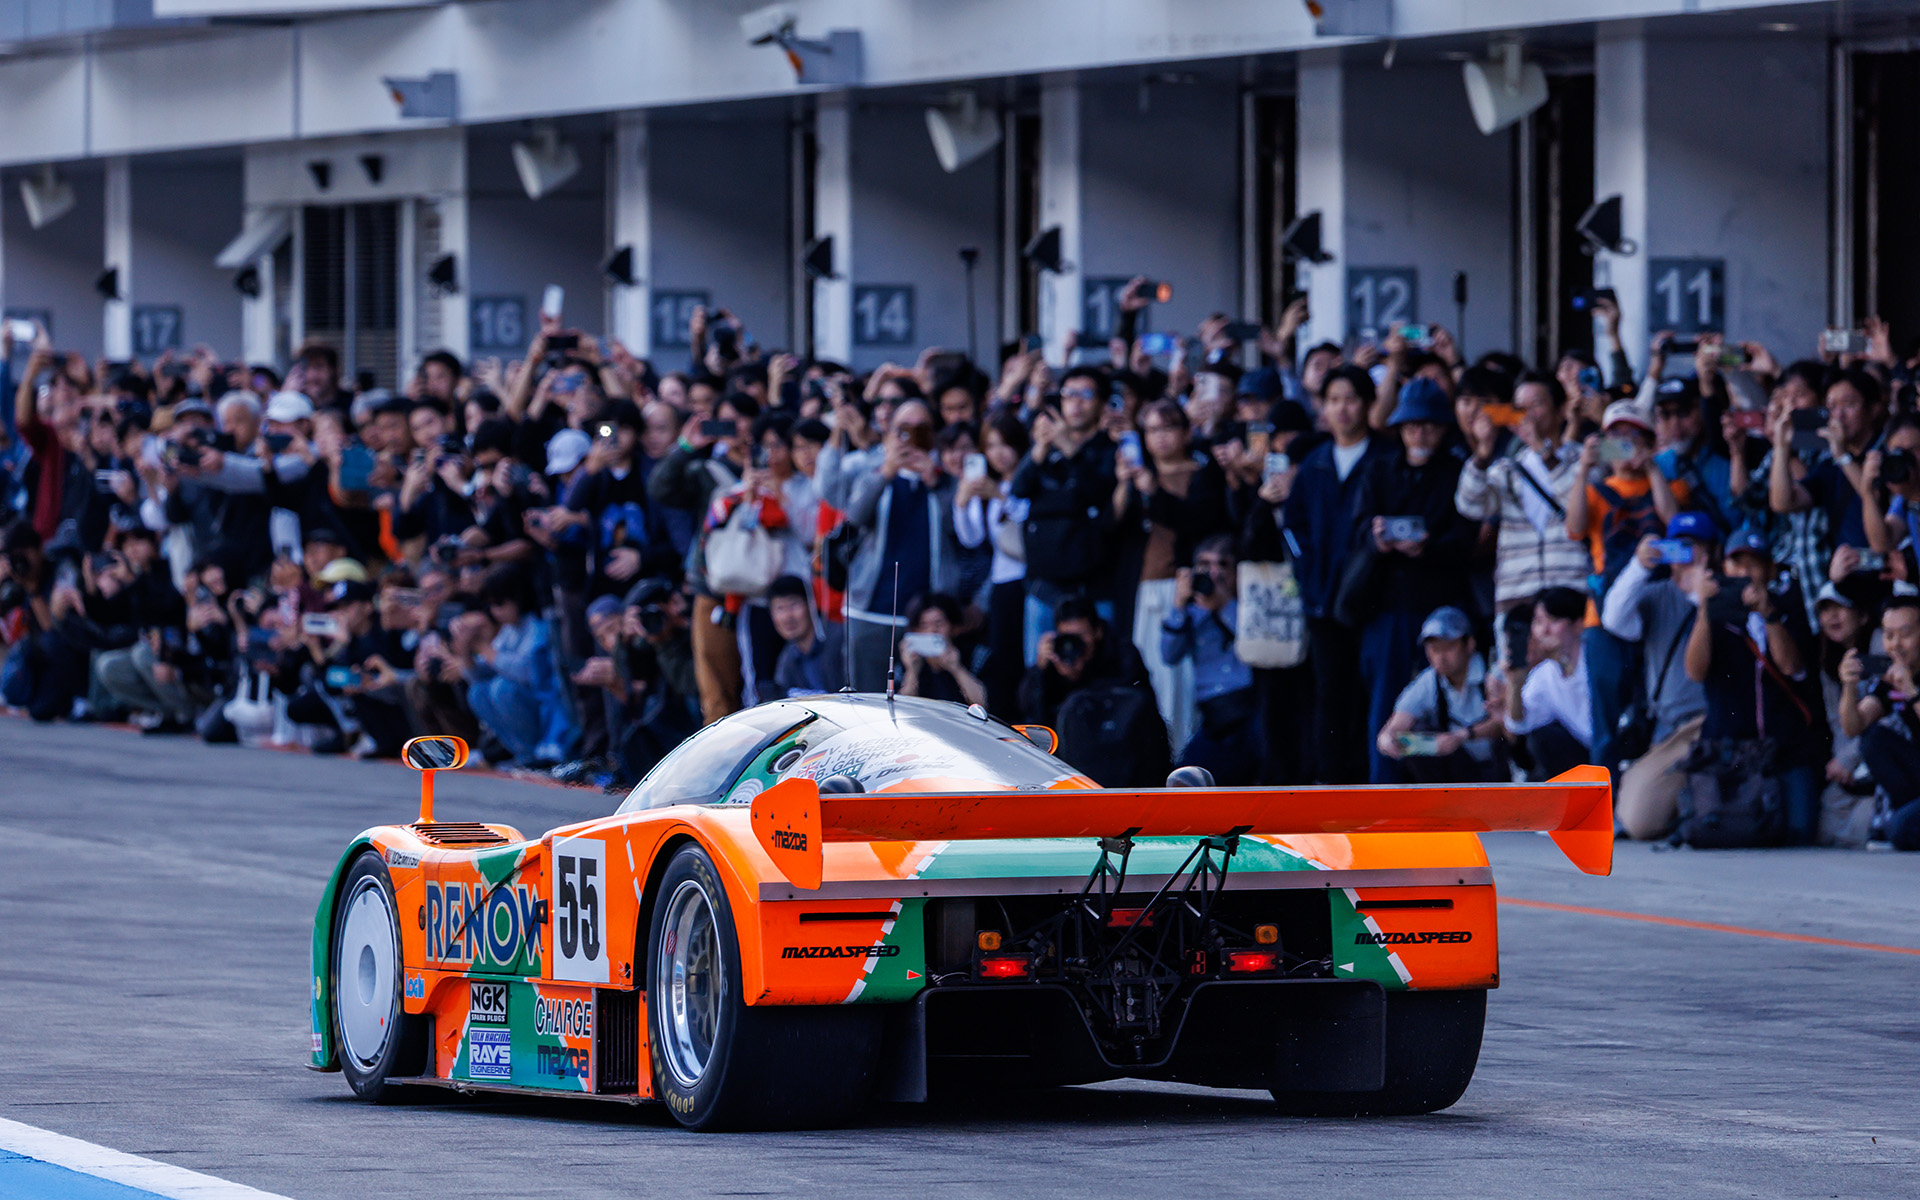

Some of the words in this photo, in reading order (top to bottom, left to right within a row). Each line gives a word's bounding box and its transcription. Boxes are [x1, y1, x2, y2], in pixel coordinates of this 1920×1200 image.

[1352, 276, 1410, 327] 12
[1656, 267, 1711, 324] 11
[477, 302, 521, 344] 16
[857, 292, 909, 339] 14
[139, 313, 175, 348] 17
[815, 768, 829, 780] B.
[832, 749, 906, 772] GACHOT
[820, 757, 834, 768] J.
[838, 743, 920, 760] HERBERT
[829, 745, 841, 755] V.
[775, 830, 808, 851] mazda
[558, 855, 600, 962] 55
[781, 945, 900, 959] MAZDASPEED
[1354, 931, 1473, 945] MAZDASPEED
[471, 986, 505, 1013] NGK
[471, 1014, 486, 1022] SPARK
[534, 995, 592, 1039] CHARGE
[470, 1044, 511, 1064] RAYS
[537, 1045, 590, 1078] mazda
[470, 1066, 511, 1074] ENGINEERING
